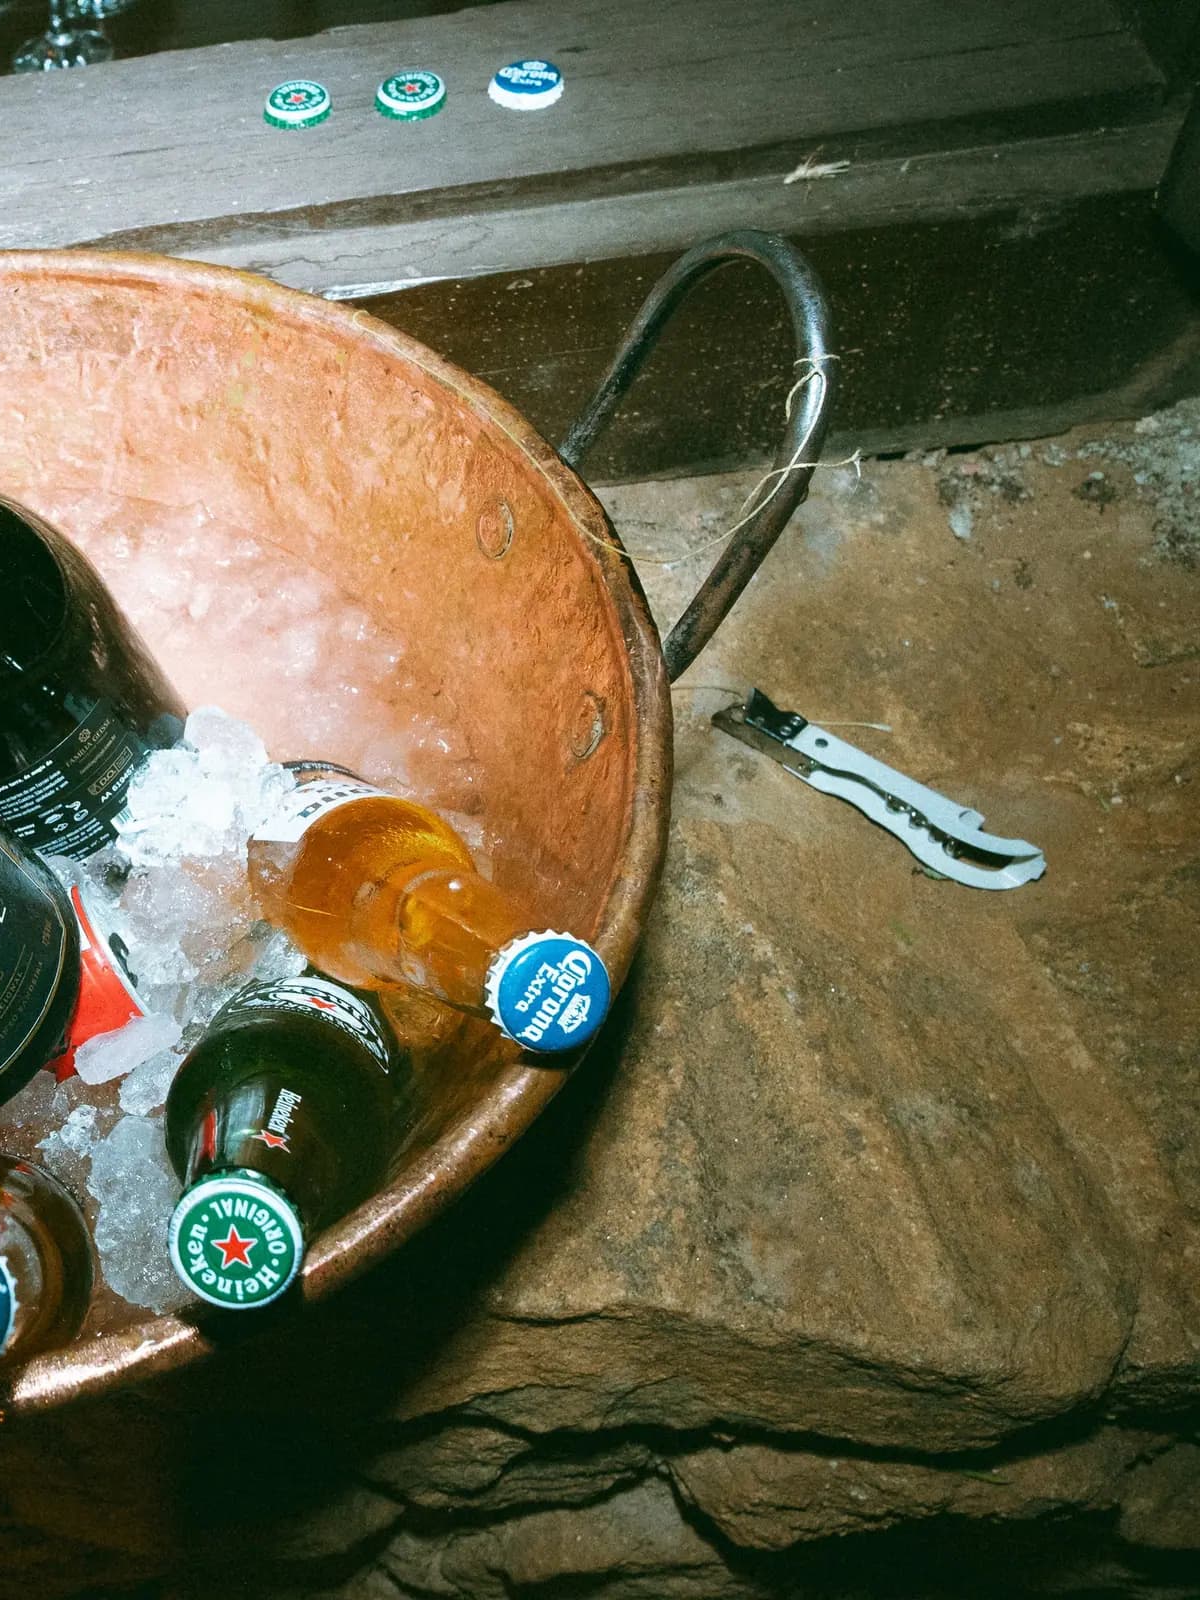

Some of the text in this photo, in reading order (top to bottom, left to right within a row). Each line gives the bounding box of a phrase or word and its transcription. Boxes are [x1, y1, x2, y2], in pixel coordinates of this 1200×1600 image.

[515, 962, 560, 1013] Extra
[516, 950, 592, 1042] Corona
[268, 1088, 302, 1134] Heineken
[209, 1198, 287, 1254] ORIGINAL
[187, 1223, 280, 1300] Heineken
